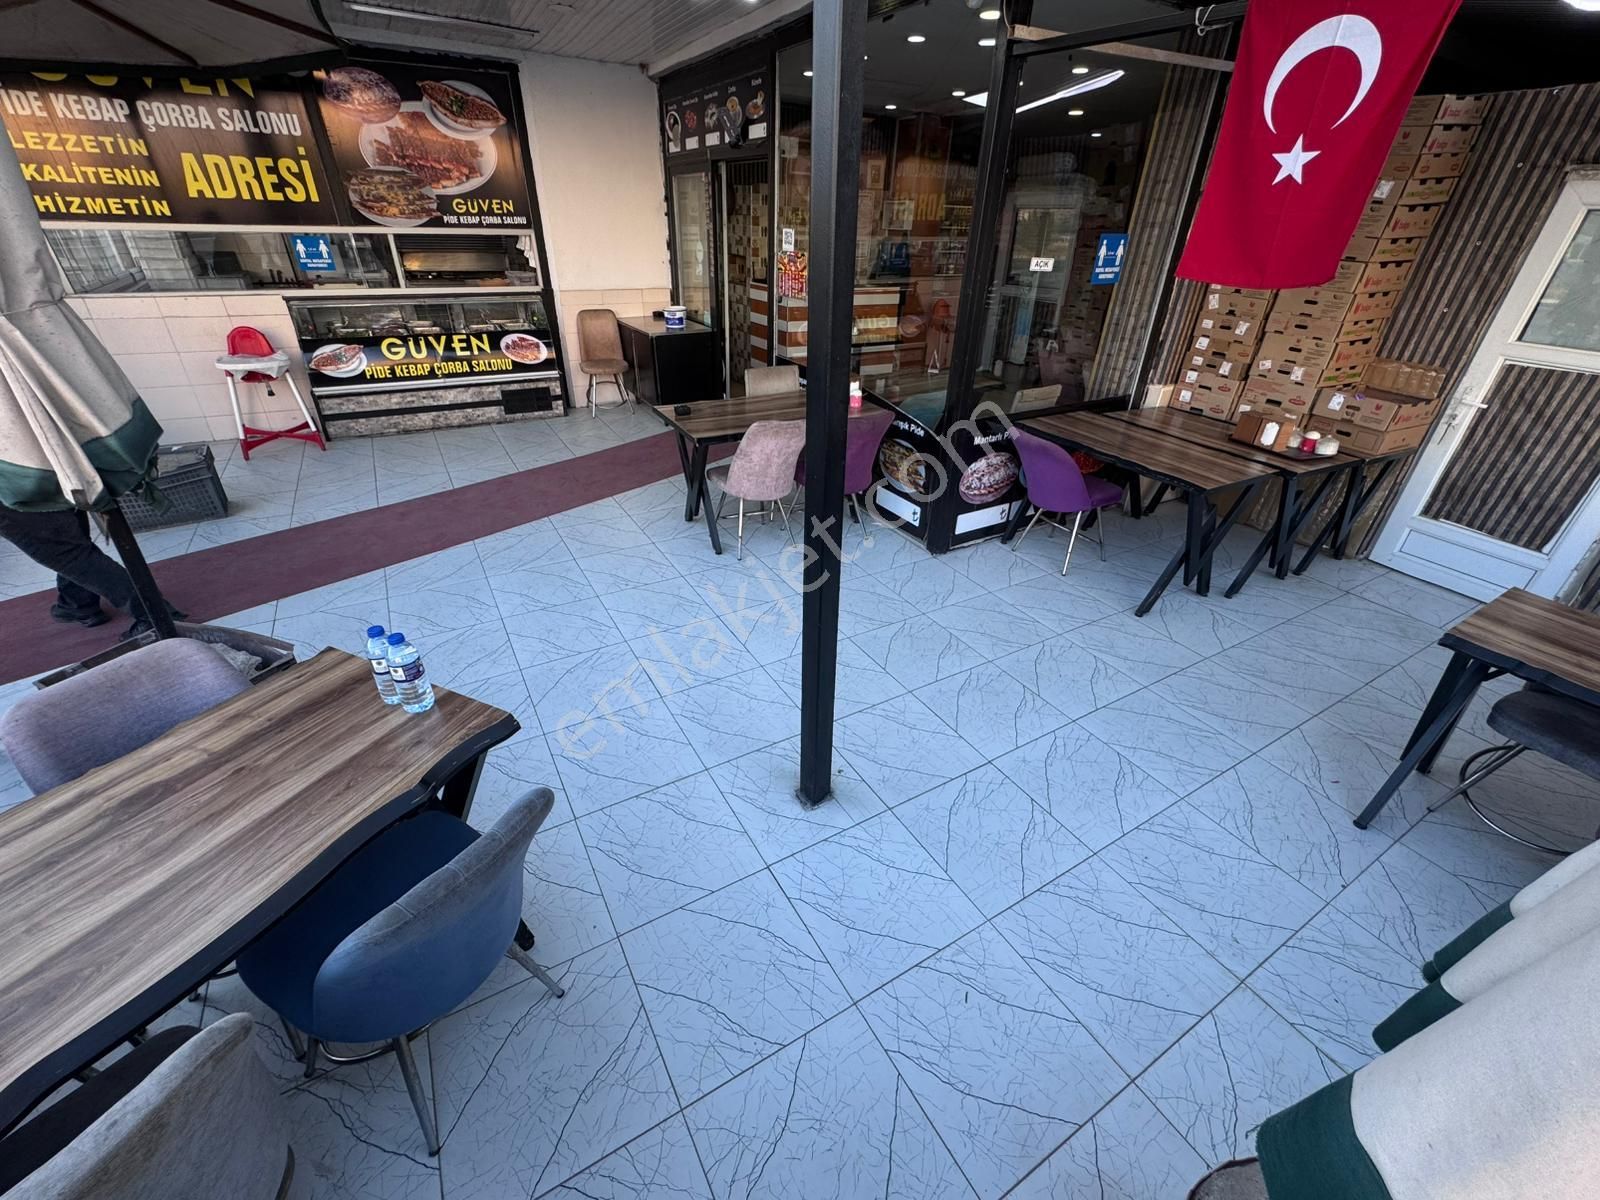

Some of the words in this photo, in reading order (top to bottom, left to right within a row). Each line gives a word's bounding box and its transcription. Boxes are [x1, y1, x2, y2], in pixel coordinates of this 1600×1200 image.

[0, 81, 48, 117] İDE
[48, 92, 130, 123] KEBAP
[137, 100, 215, 132] ÇORBA
[216, 107, 302, 136] SALONU
[7, 129, 149, 157] LEZZETİN
[21, 161, 161, 188] KALİTENİN
[180, 146, 320, 203] ADRESİ
[33, 194, 172, 217] HİZMETİN
[452, 198, 514, 214] GÜVEN
[443, 213, 458, 224] PİDE
[459, 215, 480, 224] KEBAP
[481, 215, 502, 226] ÇORBA
[502, 216, 527, 225] SALONU
[380, 334, 491, 361] GÜVEN
[365, 363, 393, 380] PİDE
[394, 363, 431, 378] KEBAP
[434, 361, 470, 379] ÇORBA
[472, 358, 513, 374] SALONU
[909, 423, 924, 437] Pide
